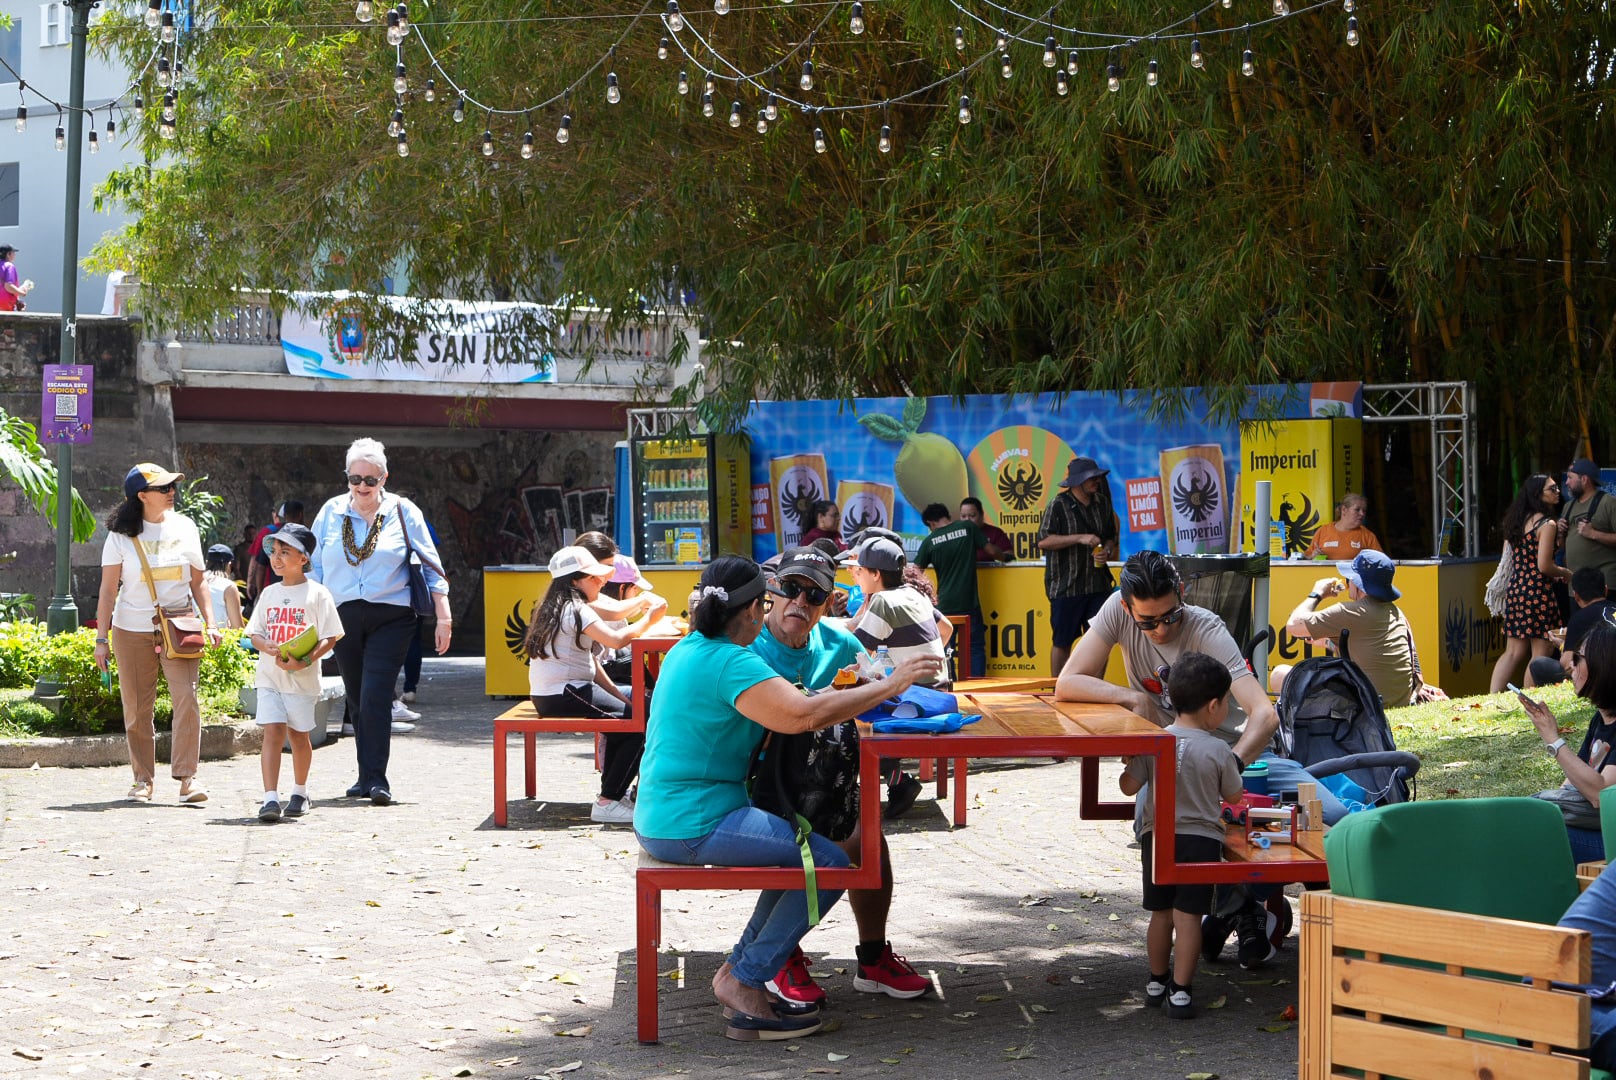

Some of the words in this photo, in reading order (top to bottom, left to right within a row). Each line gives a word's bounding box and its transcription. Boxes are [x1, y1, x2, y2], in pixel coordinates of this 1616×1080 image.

[427, 333, 476, 363] SAN
[990, 447, 1029, 472] NUEVAS
[1250, 448, 1317, 475] Imperial
[727, 459, 740, 530] Imperial
[1128, 480, 1160, 497] MANGO
[1130, 494, 1158, 512] LIMÓN
[1000, 511, 1044, 527] Imperial
[1131, 514, 1138, 527] Y
[1140, 512, 1157, 526] SAL
[946, 528, 967, 541] KLEEN
[1176, 521, 1223, 543] Imperial
